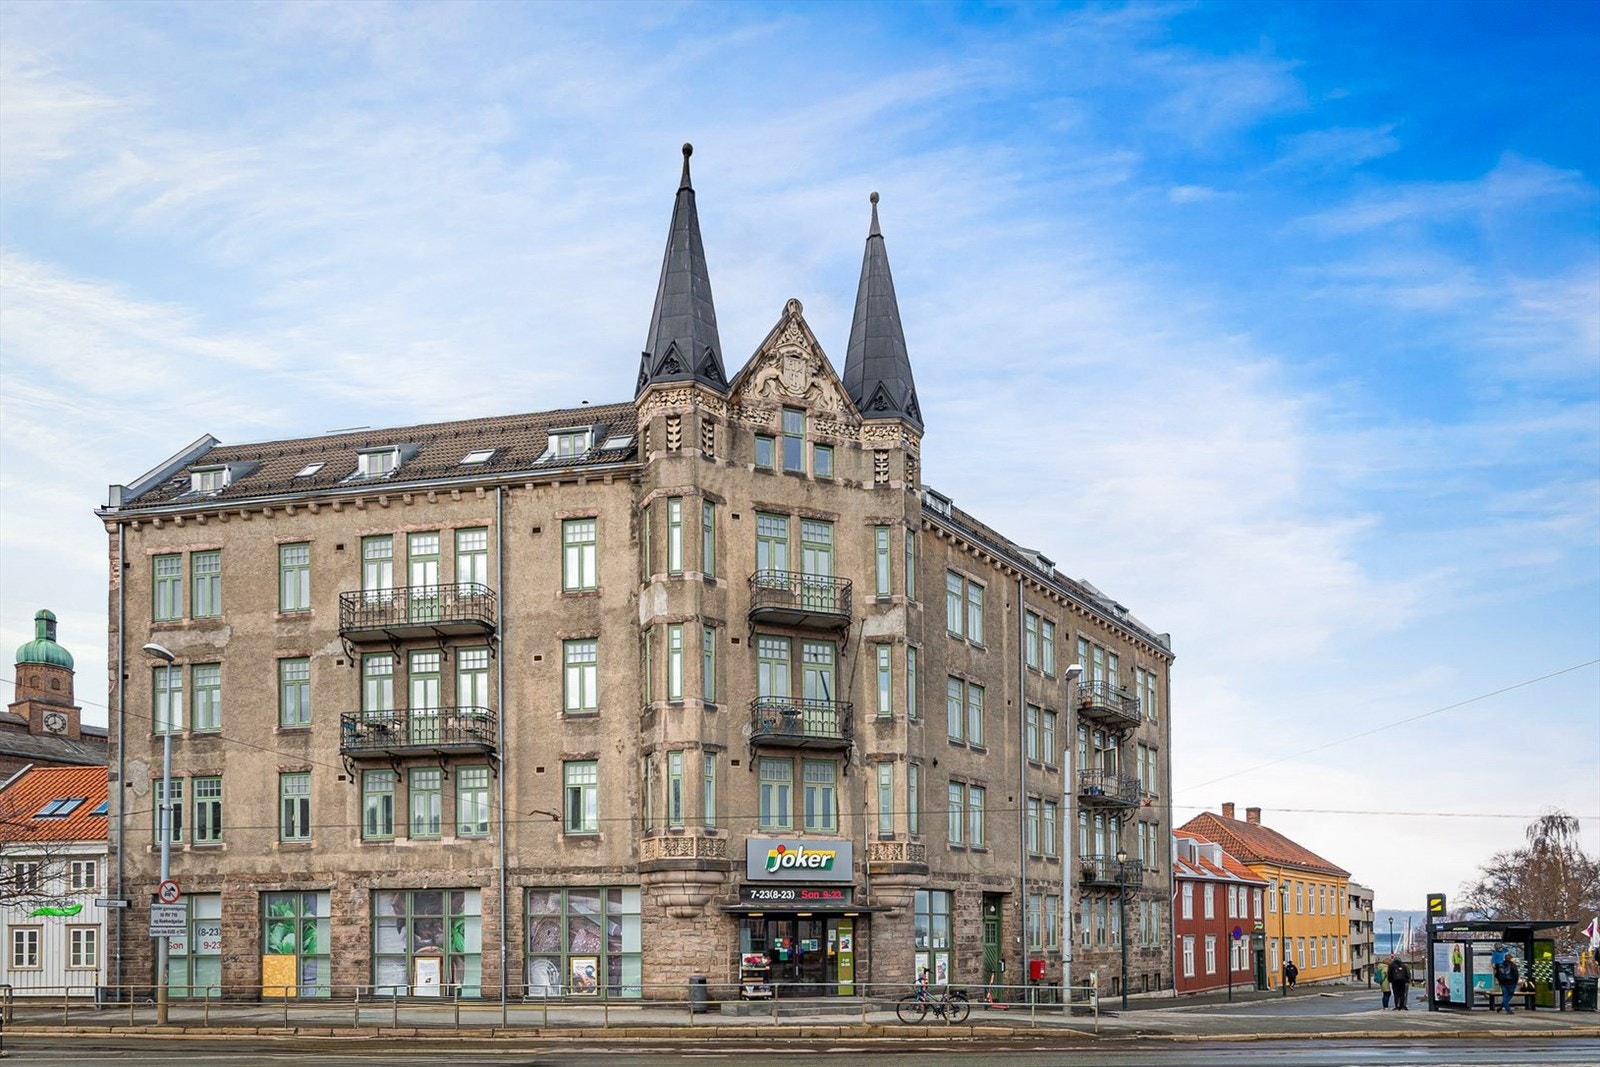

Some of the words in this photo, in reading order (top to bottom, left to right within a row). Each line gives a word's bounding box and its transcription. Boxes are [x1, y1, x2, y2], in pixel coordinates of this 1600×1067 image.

[769, 845, 831, 873] joker
[751, 890, 795, 900] 7-23(8-23)
[823, 891, 842, 899] 9-23
